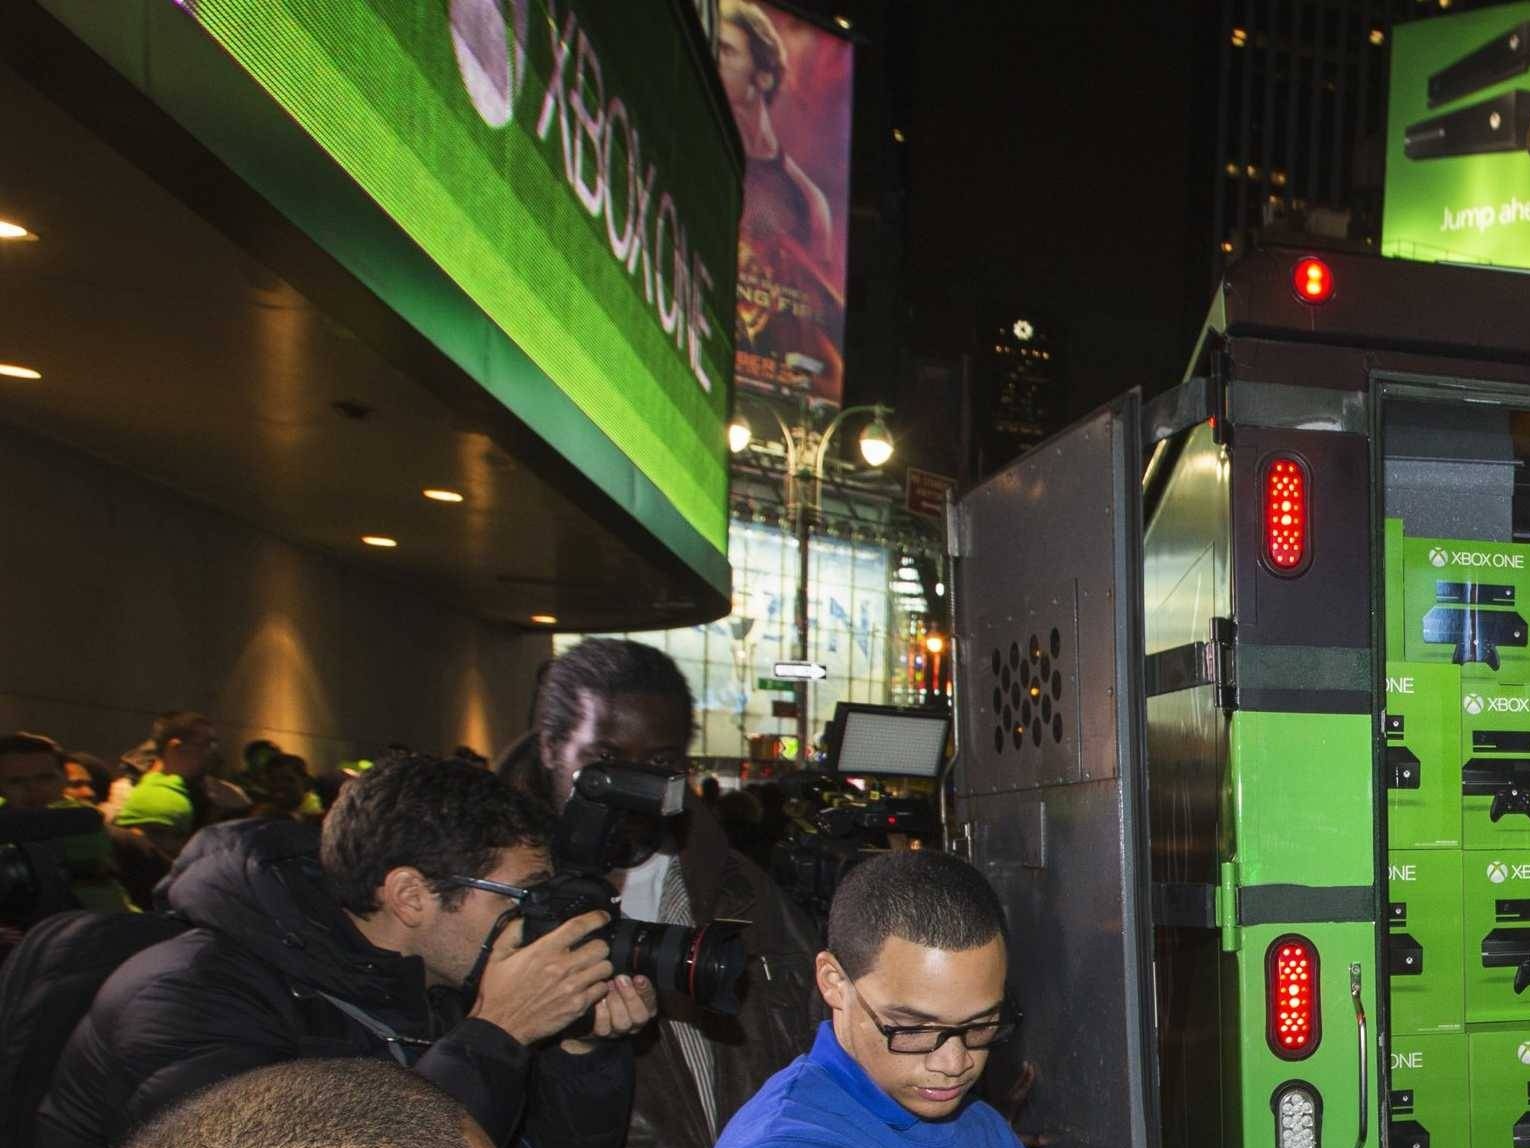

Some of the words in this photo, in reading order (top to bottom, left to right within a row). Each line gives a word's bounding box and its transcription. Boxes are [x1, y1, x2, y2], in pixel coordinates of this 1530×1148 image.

[537, 0, 656, 304] XBOX
[655, 192, 713, 393] ONE
[1439, 204, 1496, 233] Jump
[1451, 551, 1491, 566] XBOX
[1492, 553, 1525, 569] ONE
